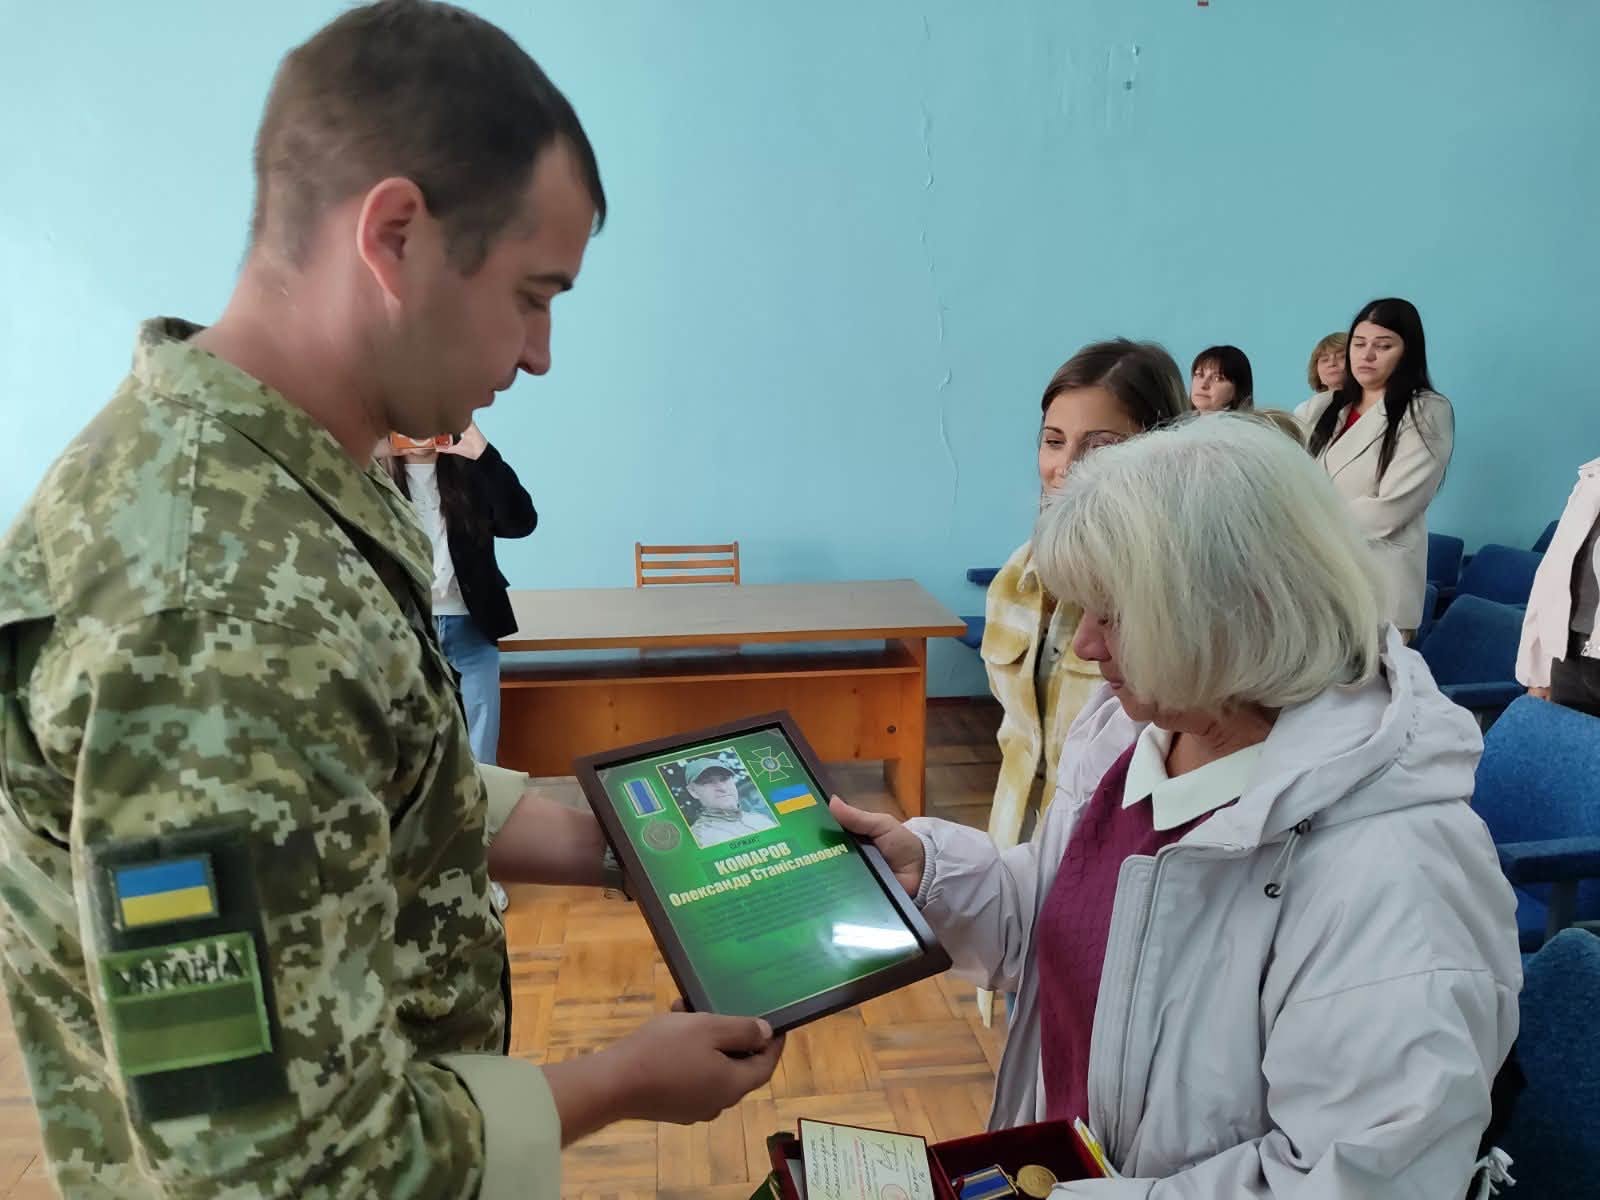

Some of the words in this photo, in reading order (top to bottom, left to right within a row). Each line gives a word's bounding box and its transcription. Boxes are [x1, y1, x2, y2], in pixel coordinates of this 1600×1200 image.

[669, 874, 751, 907] Олександр
[750, 843, 849, 881] Станіславович
[714, 841, 791, 875] КОМАРОВ
